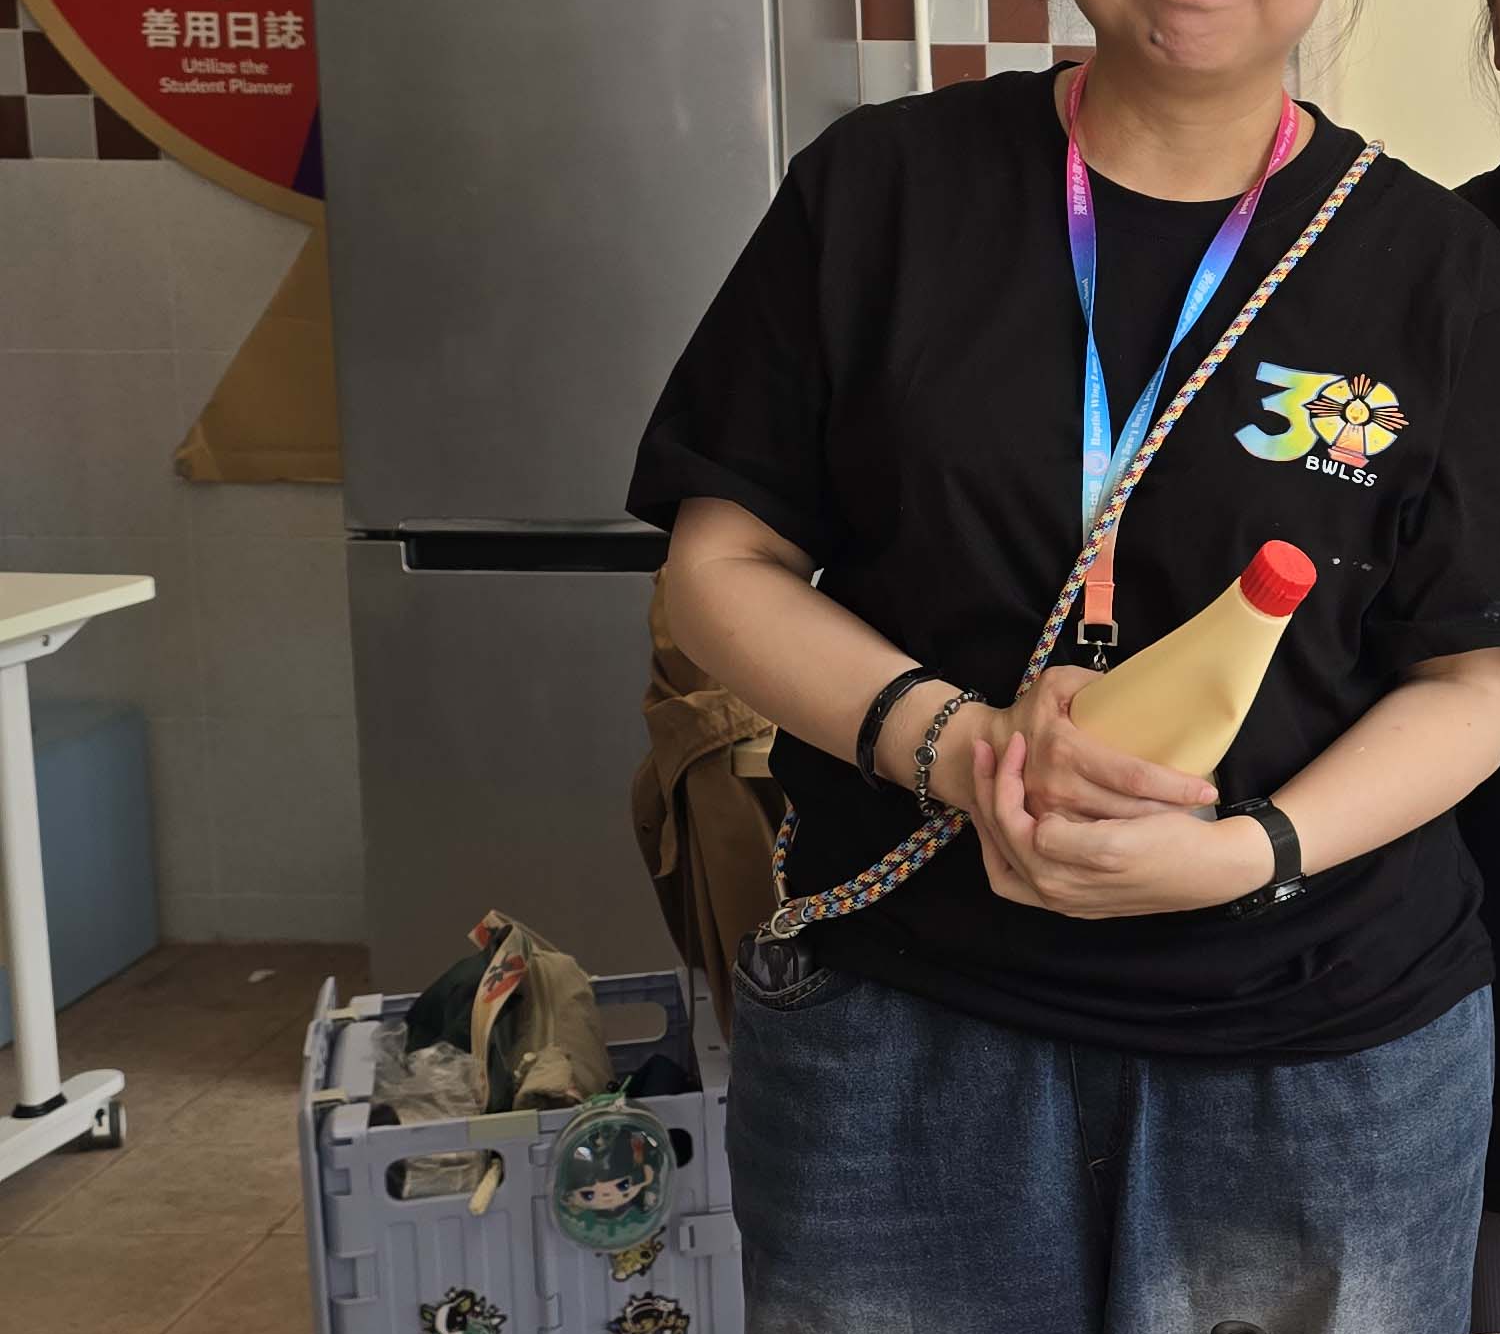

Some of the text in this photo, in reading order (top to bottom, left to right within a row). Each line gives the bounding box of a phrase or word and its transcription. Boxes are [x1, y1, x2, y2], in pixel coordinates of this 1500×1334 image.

[141, 7, 306, 49] 善用日誌
[240, 59, 269, 75] the
[160, 77, 293, 95] Student Planner
[1305, 455, 1378, 487] BWLSS
